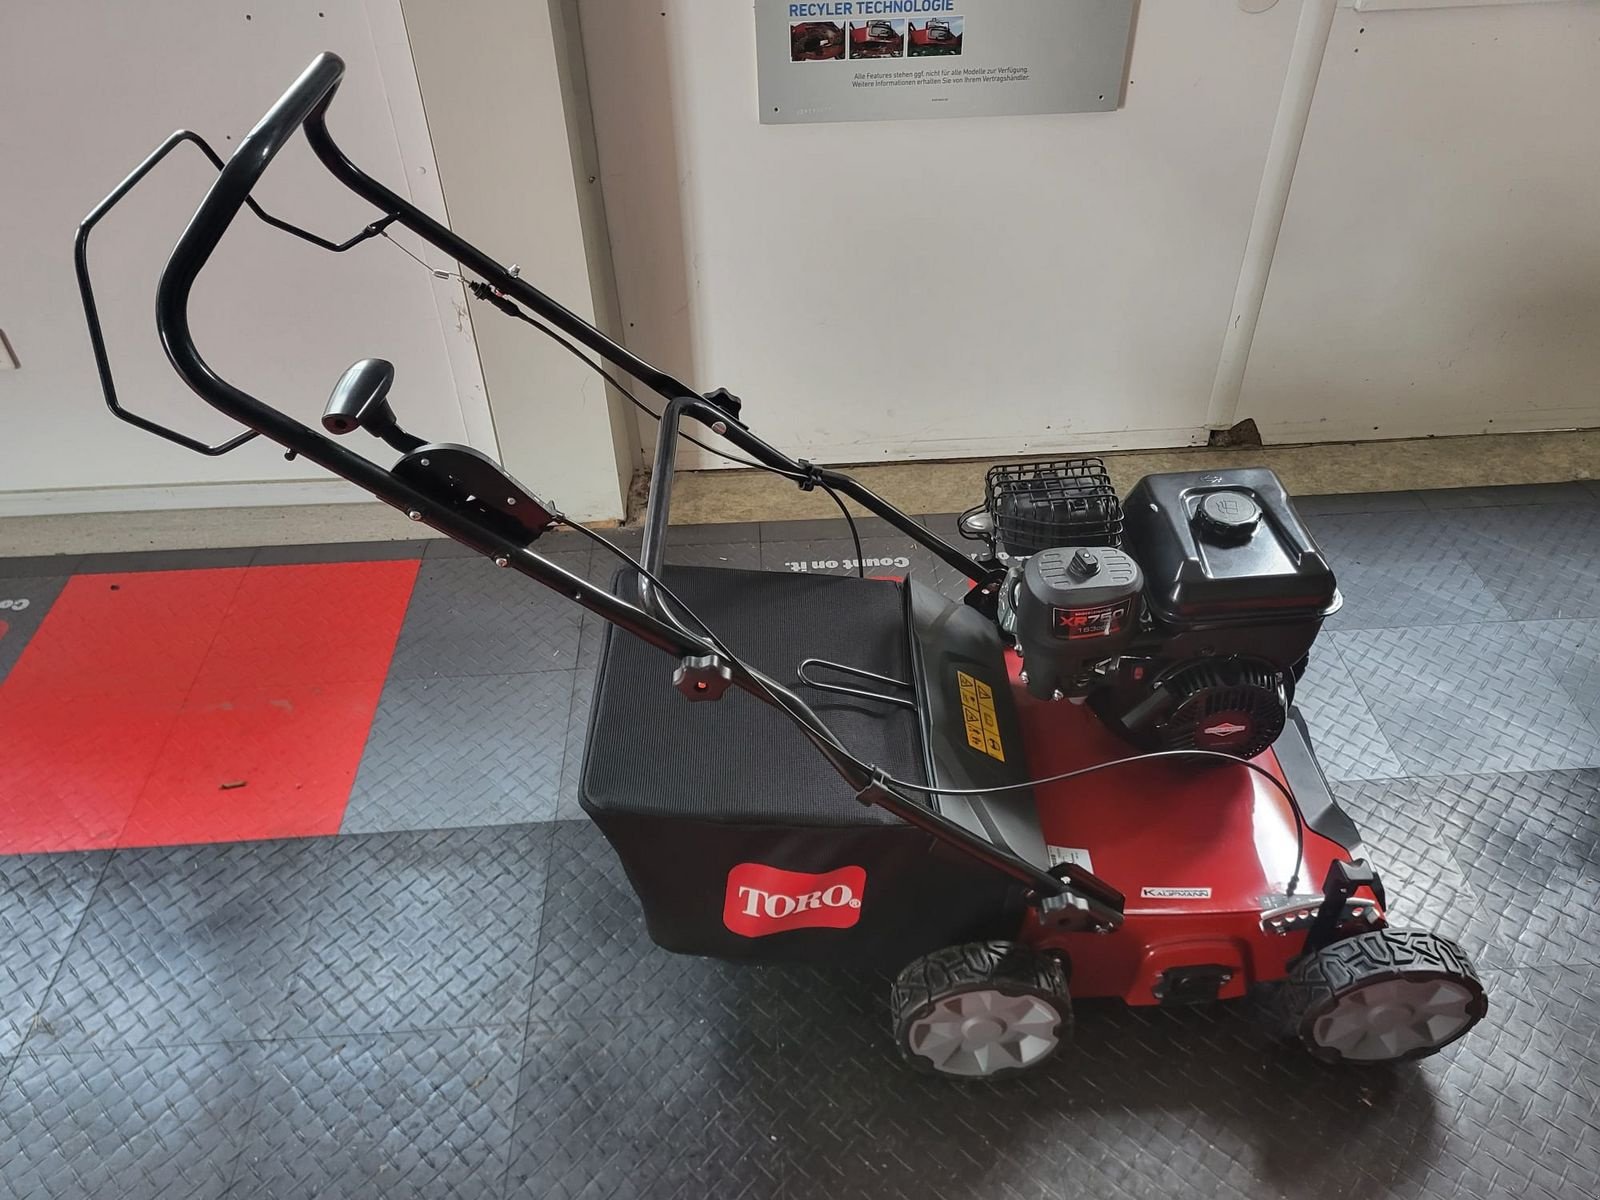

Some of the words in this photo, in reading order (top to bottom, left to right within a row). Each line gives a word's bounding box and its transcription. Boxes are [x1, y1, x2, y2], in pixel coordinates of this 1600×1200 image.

[789, 3, 853, 17] RECYLER
[856, 0, 954, 15] TECHNOLOGIE
[854, 72, 866, 80] Alle
[866, 72, 893, 80] Features
[893, 71, 914, 79] stehen
[925, 69, 941, 77] nicht
[951, 68, 962, 76] alle
[963, 67, 986, 75] Modelle
[851, 80, 875, 88] Weitere
[875, 79, 916, 87] Informationen
[916, 78, 942, 86] erhalten
[811, 557, 839, 569] on
[842, 556, 910, 570] Count
[1059, 608, 1125, 627] XR750
